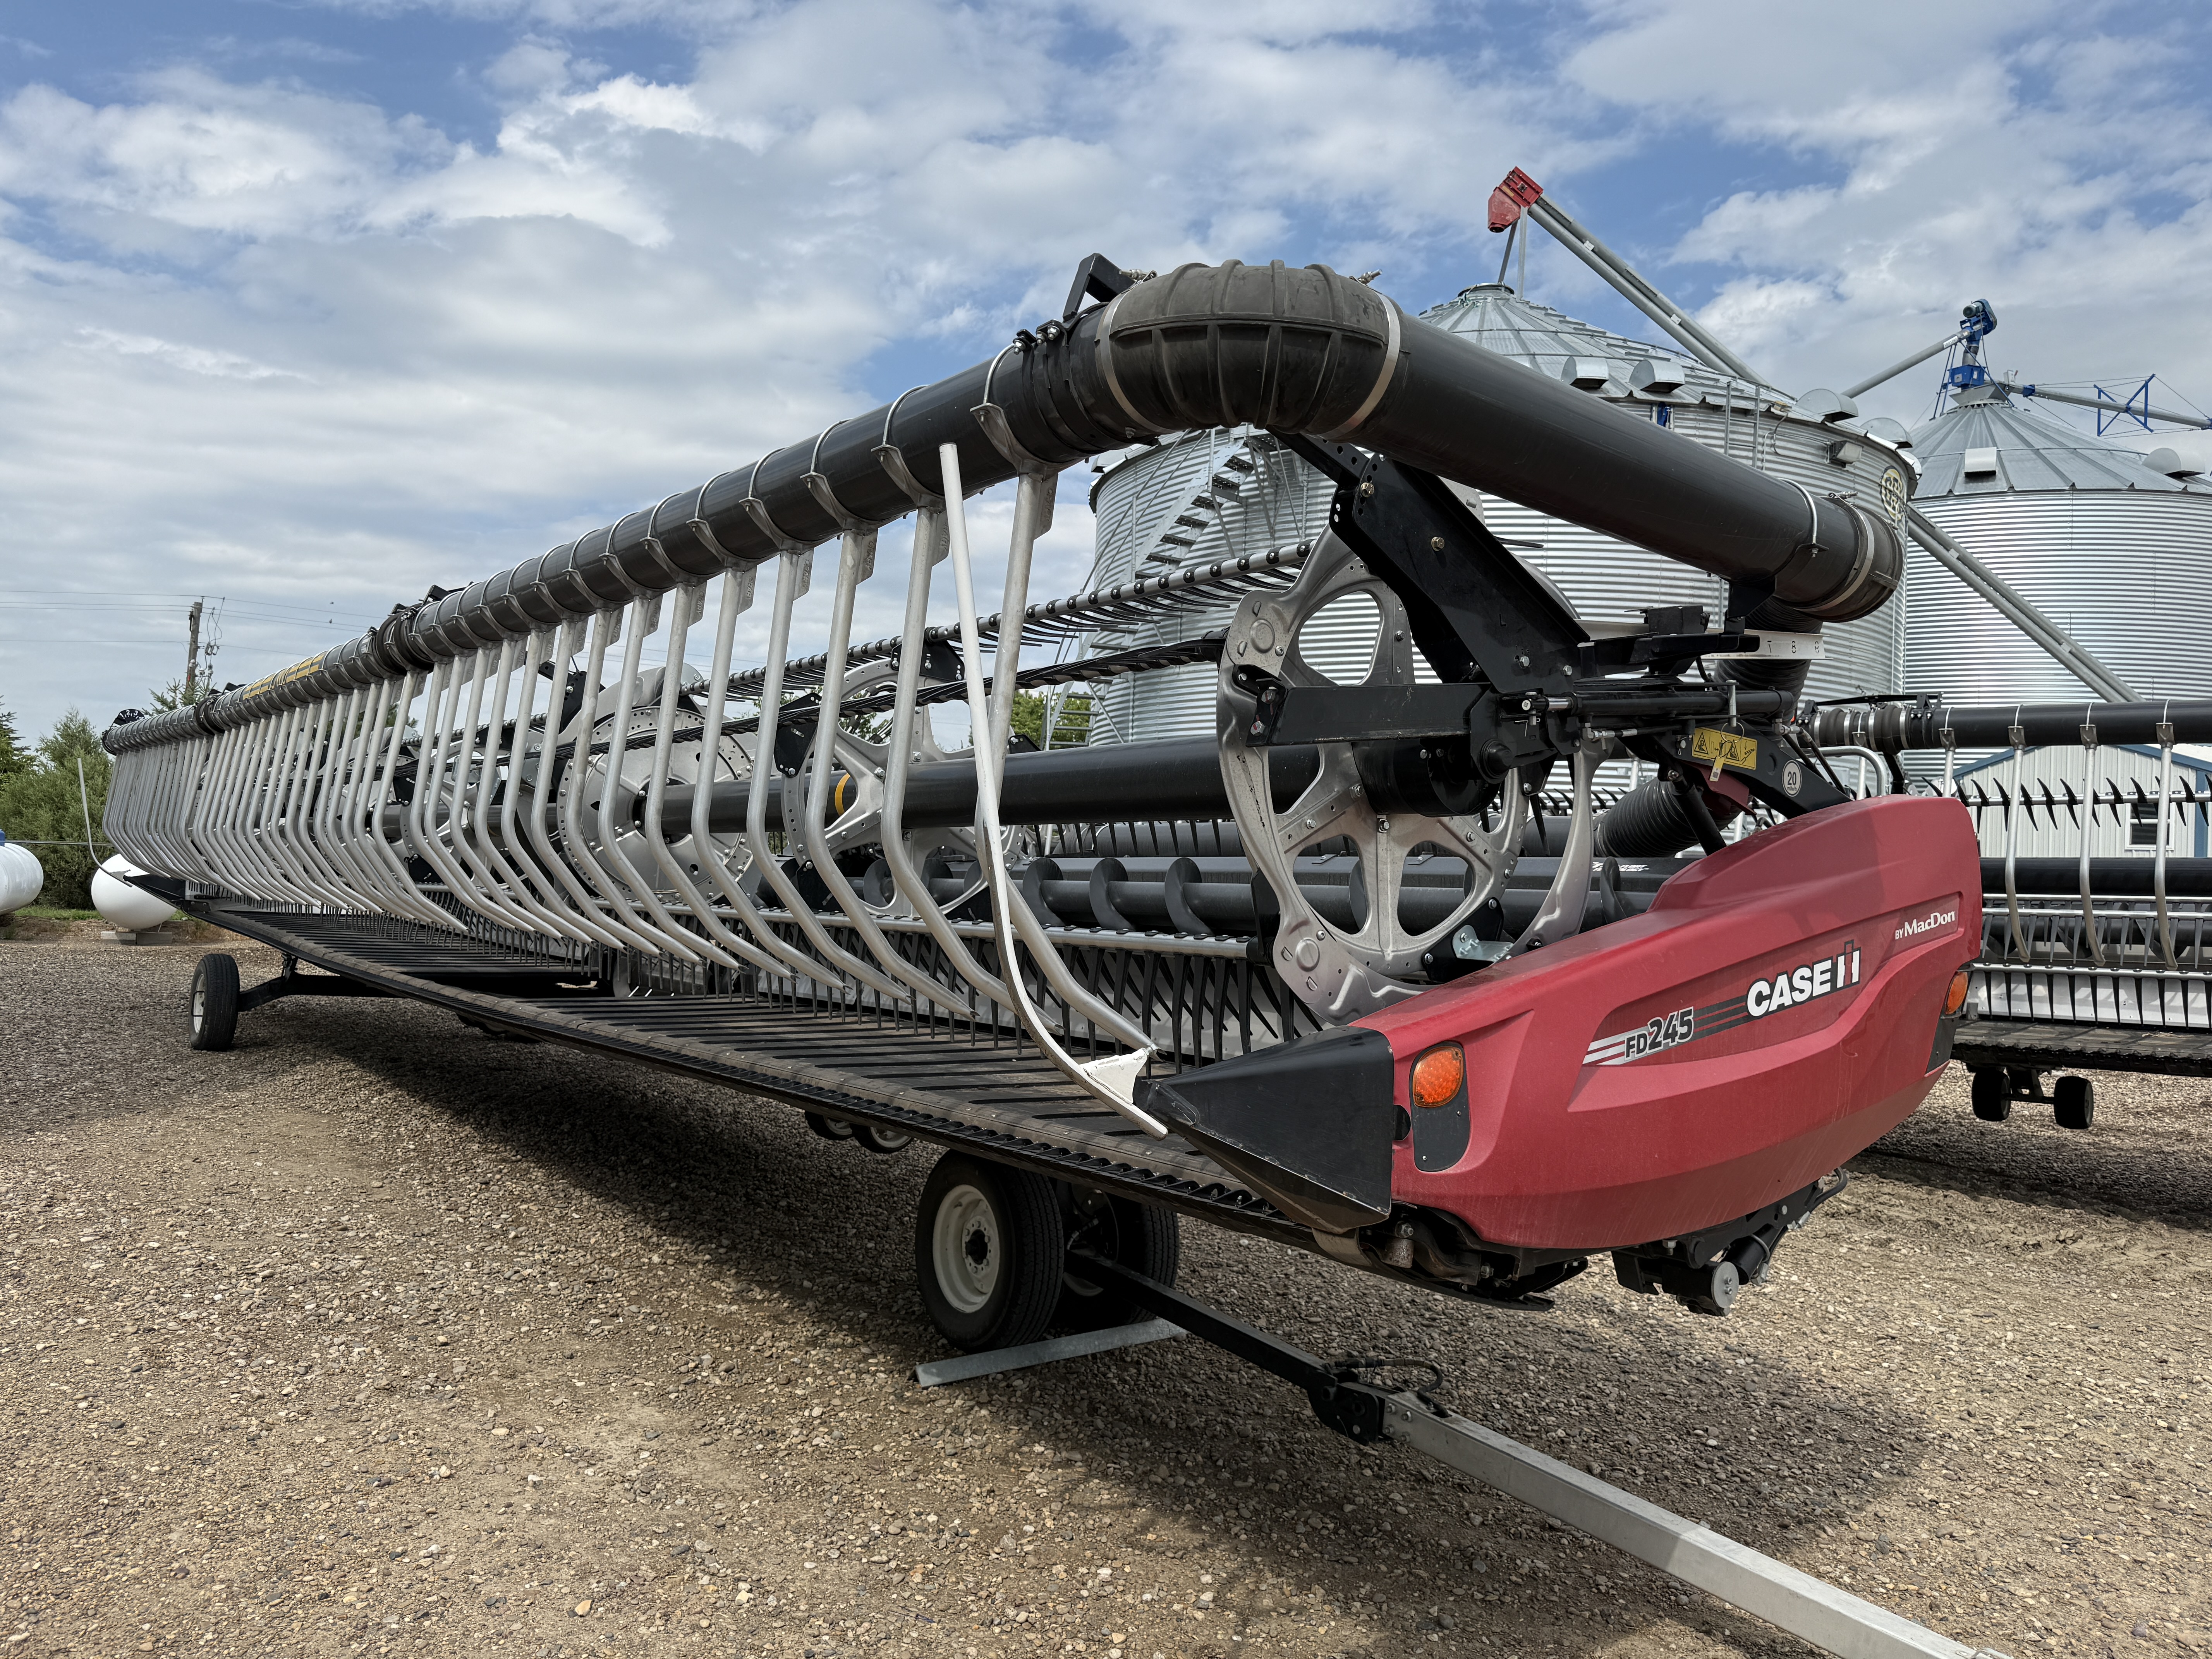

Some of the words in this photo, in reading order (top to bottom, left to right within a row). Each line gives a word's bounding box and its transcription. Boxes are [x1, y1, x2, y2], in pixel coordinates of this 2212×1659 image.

[1767, 641, 1772, 653] 7
[1792, 641, 1796, 653] 8
[1815, 641, 1819, 653] 9
[1788, 771, 1796, 786] 20
[1895, 928, 1904, 940] BY
[1905, 911, 1955, 937] MacDon
[1747, 959, 1832, 1017] CASE
[1625, 1006, 1693, 1061] FD245
